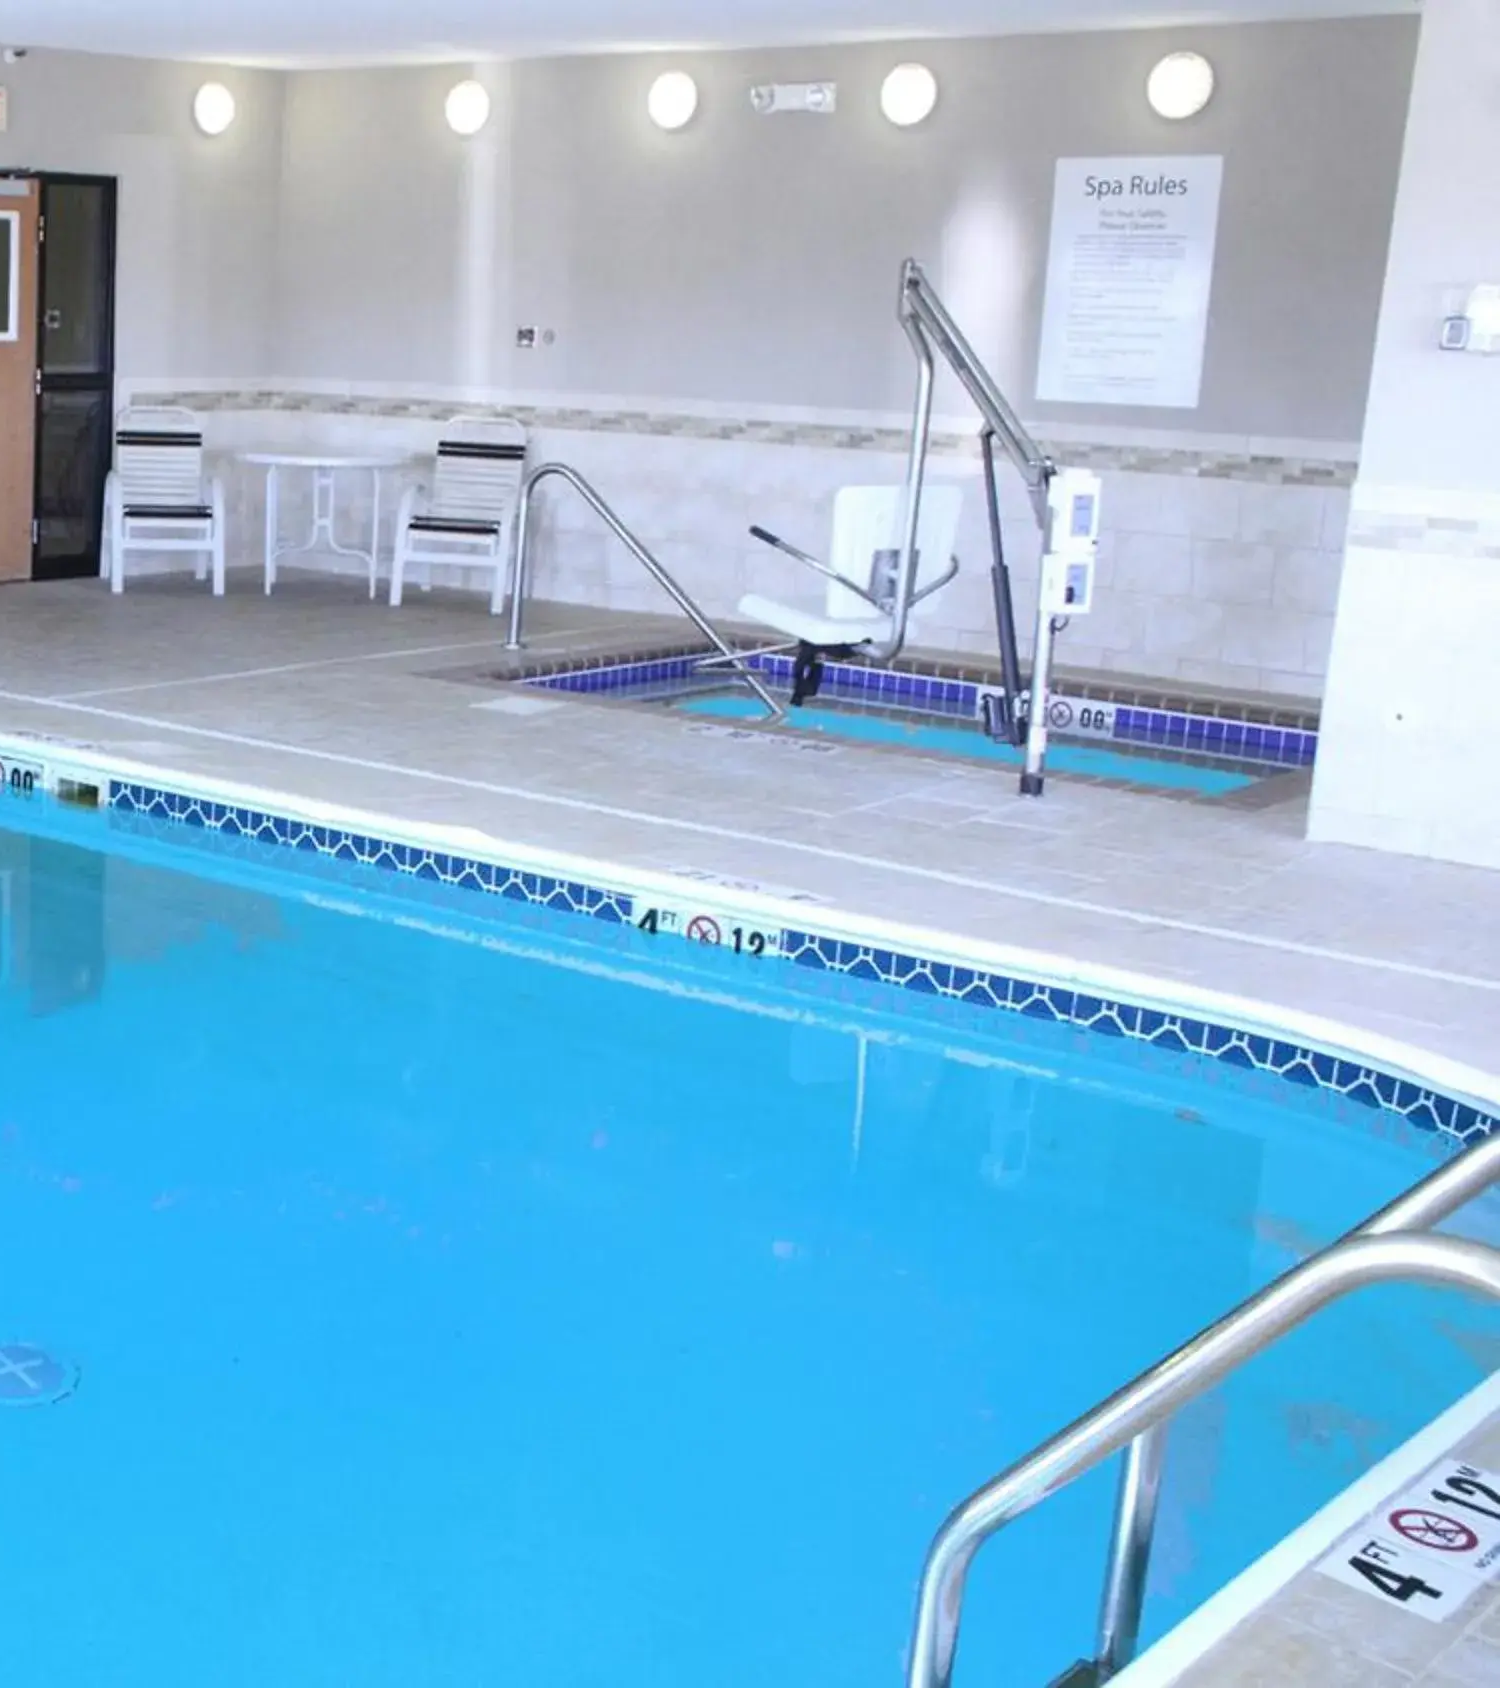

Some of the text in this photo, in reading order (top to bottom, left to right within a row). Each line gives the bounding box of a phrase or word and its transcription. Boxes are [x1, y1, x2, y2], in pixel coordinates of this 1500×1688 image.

[1084, 174, 1188, 201] Spa Rules
[639, 908, 677, 934] 4 FT
[732, 927, 765, 955] 12
[1430, 1476, 1500, 1520] 12
[1348, 1540, 1443, 1602] 4 FT
